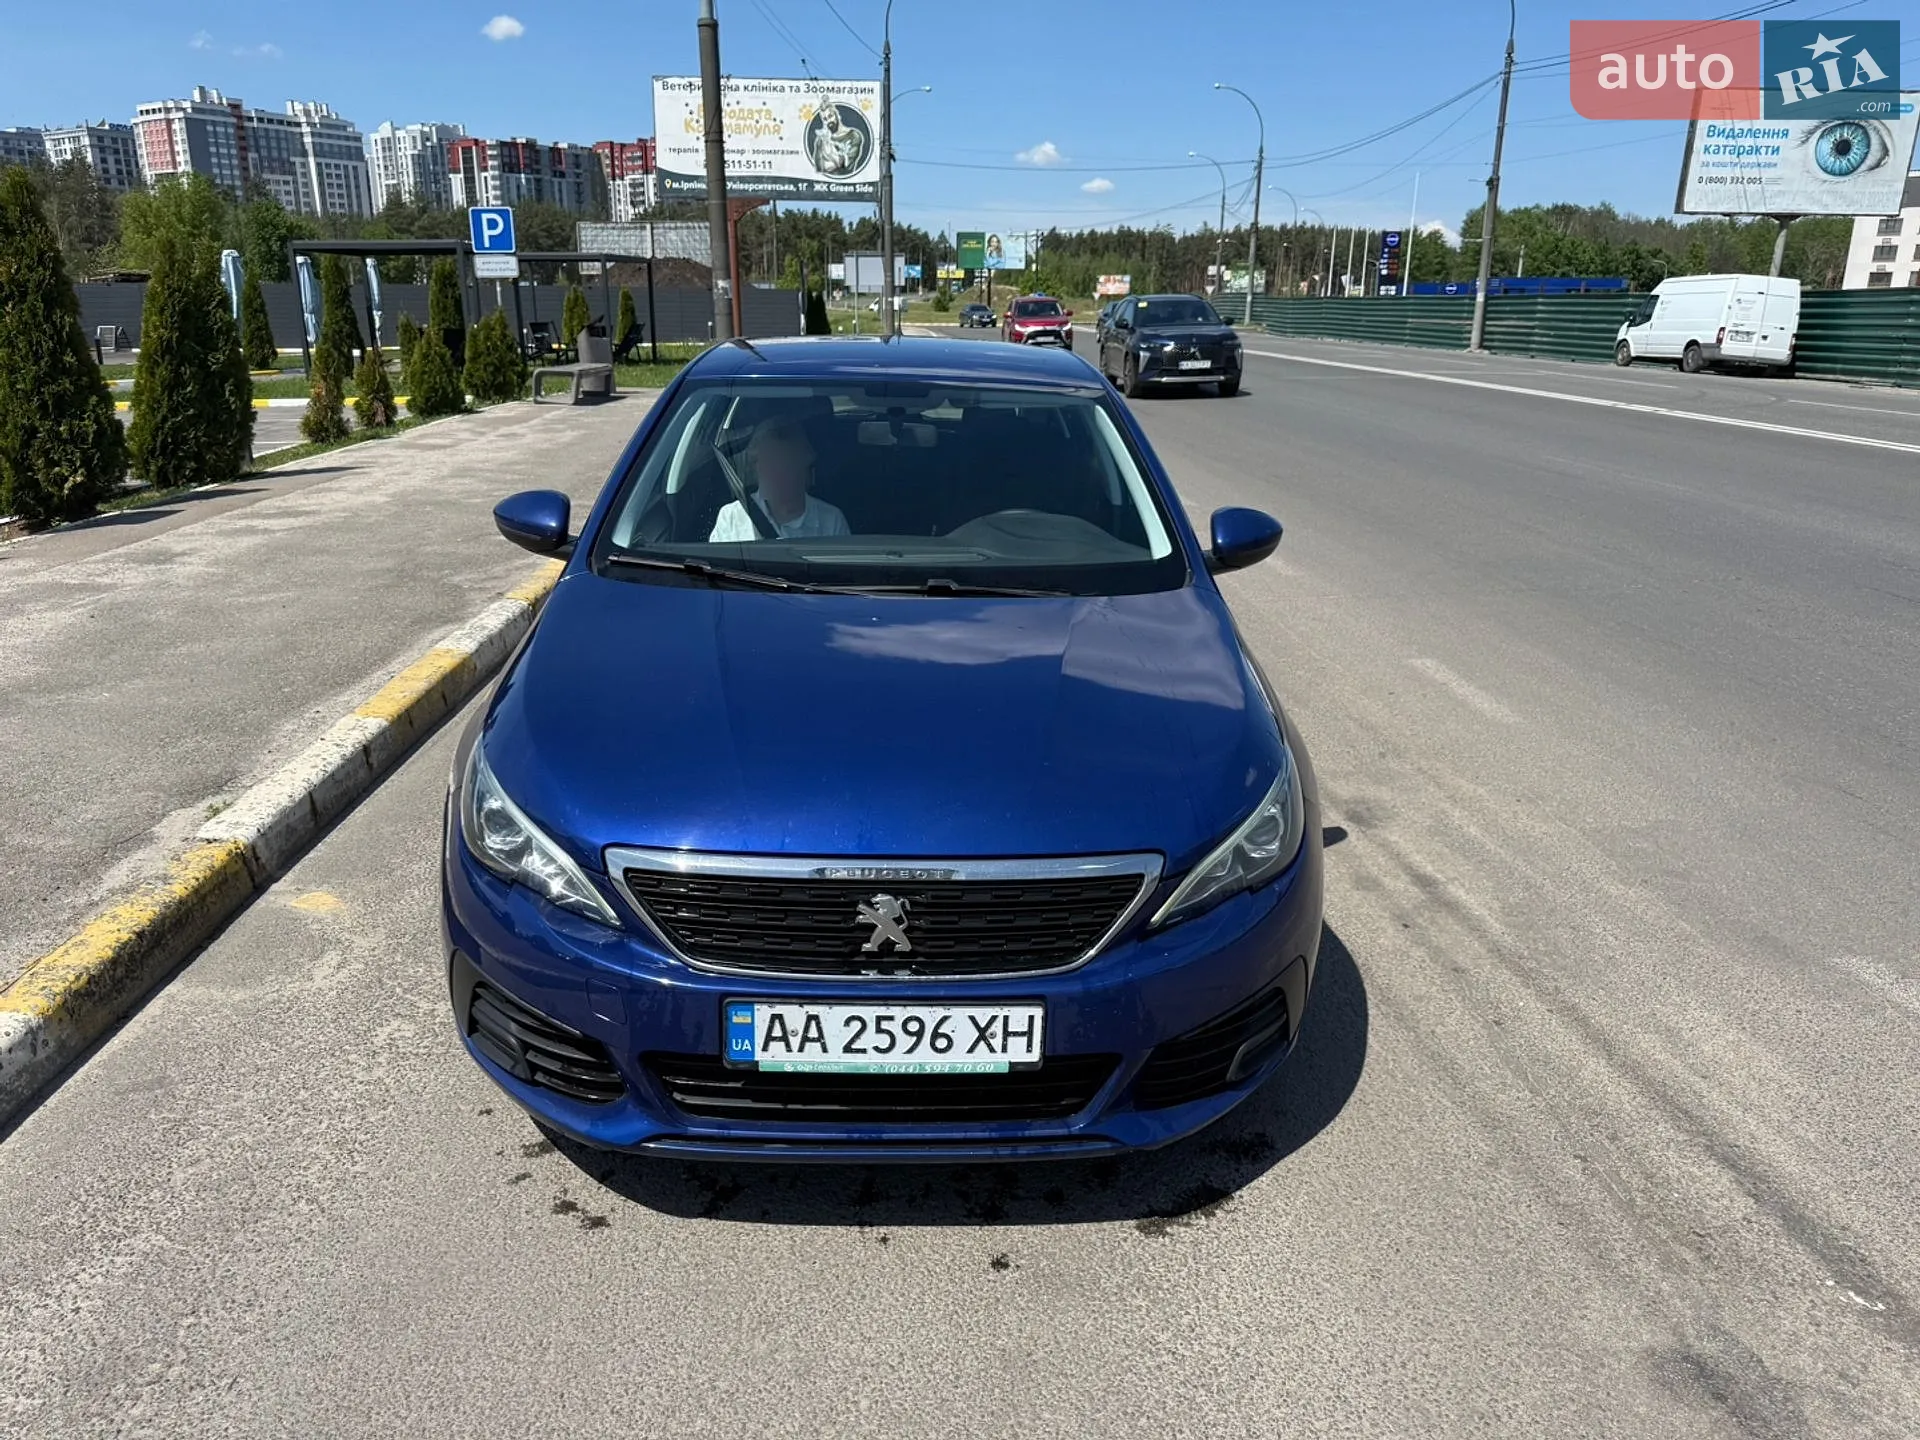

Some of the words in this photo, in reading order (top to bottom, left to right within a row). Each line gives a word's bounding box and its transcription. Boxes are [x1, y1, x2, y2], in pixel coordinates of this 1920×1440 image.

[743, 81, 785, 94] клініка
[789, 84, 801, 94] та
[803, 82, 875, 95] Зоомагазин
[1706, 125, 1789, 141] Видалення
[668, 146, 699, 156] терапія
[751, 147, 800, 156] зоомагазин
[1703, 143, 1780, 158] катаракти
[1705, 175, 1728, 185] (800)
[813, 184, 829, 192] ЖК
[829, 184, 854, 192] Green
[855, 183, 874, 193] Side
[481, 213, 504, 248] P
[830, 868, 945, 880] PEUGEOT
[761, 1012, 830, 1054] AA
[842, 1014, 954, 1055] 2596
[965, 1014, 1035, 1054] XH
[732, 1039, 752, 1051] UA
[885, 1064, 919, 1073] (044)
[924, 1064, 950, 1073] 594
[956, 1063, 972, 1072] 70
[976, 1063, 994, 1072] 60
